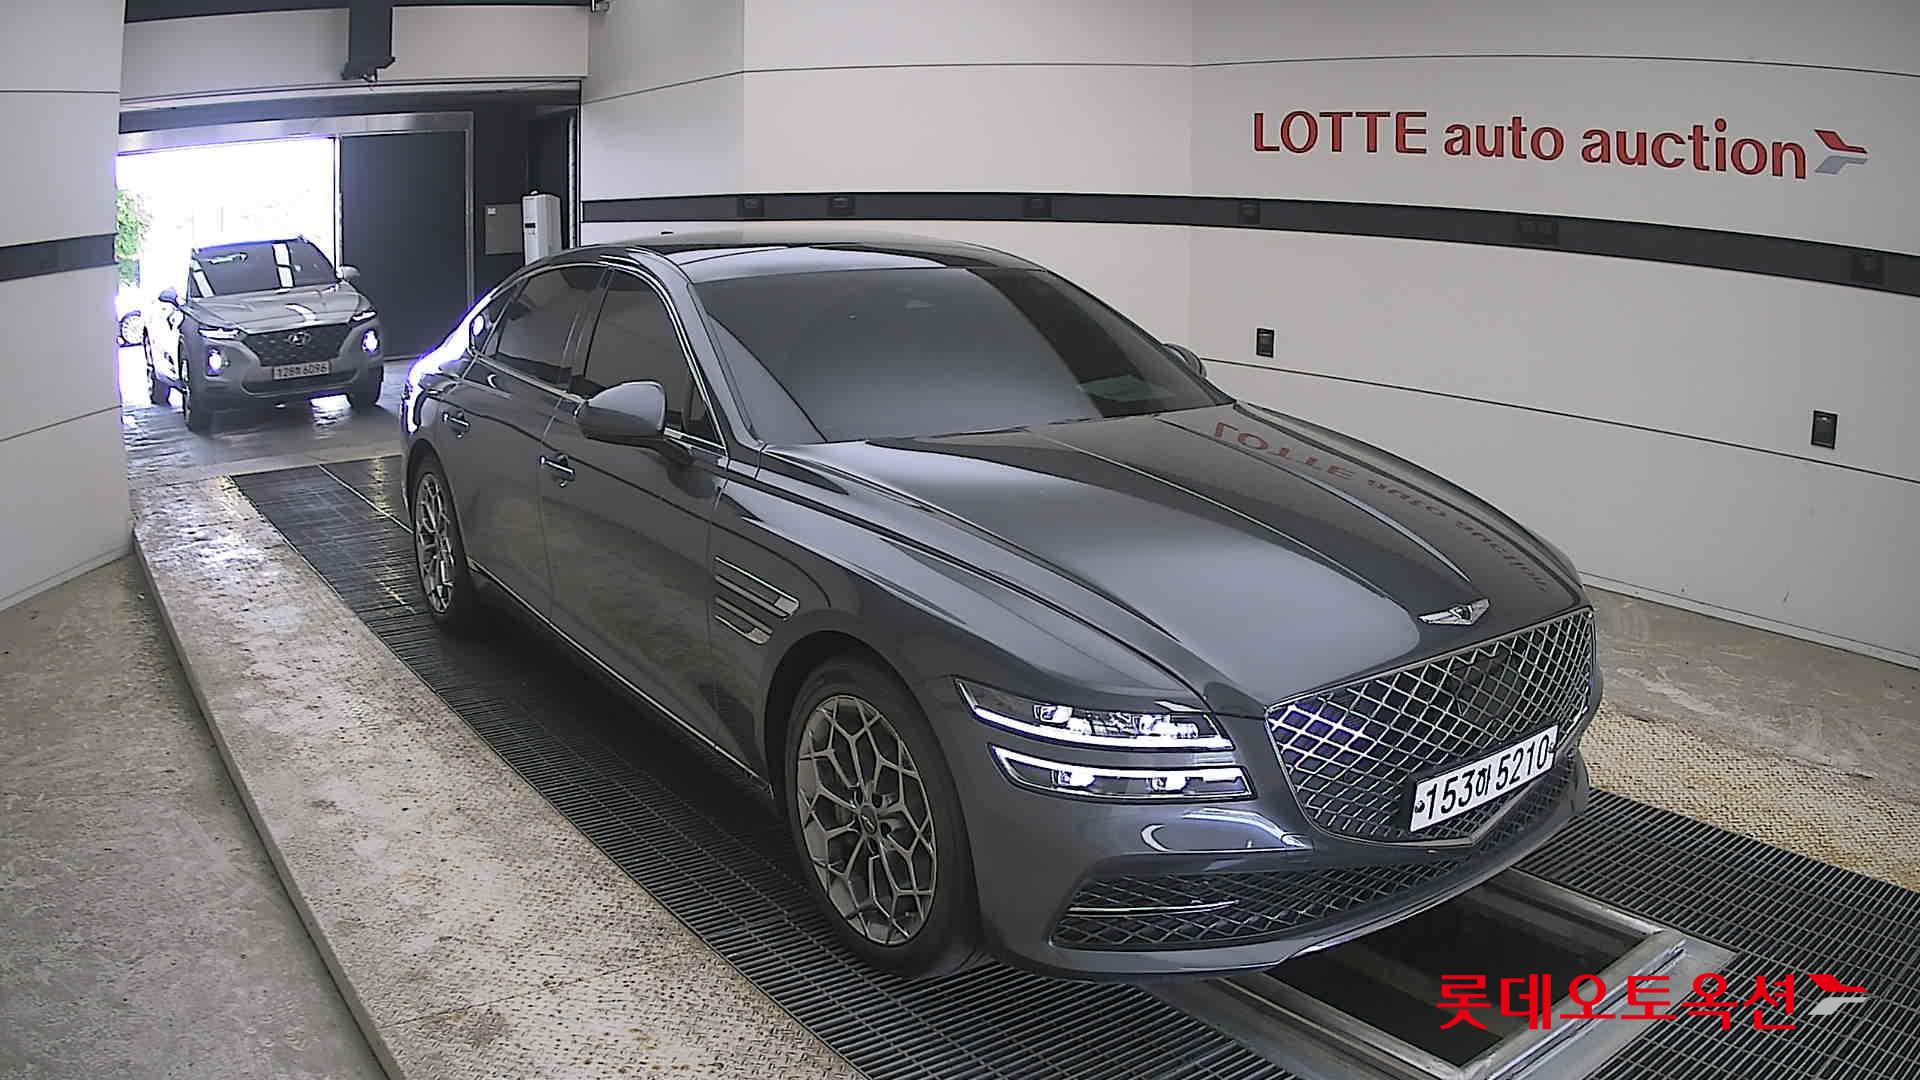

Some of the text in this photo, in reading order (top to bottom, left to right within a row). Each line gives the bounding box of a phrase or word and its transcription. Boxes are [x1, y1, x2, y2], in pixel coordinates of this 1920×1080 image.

[1254, 111, 1807, 180] LOTTE auto auction
[1425, 734, 1550, 820] 153하 5210
